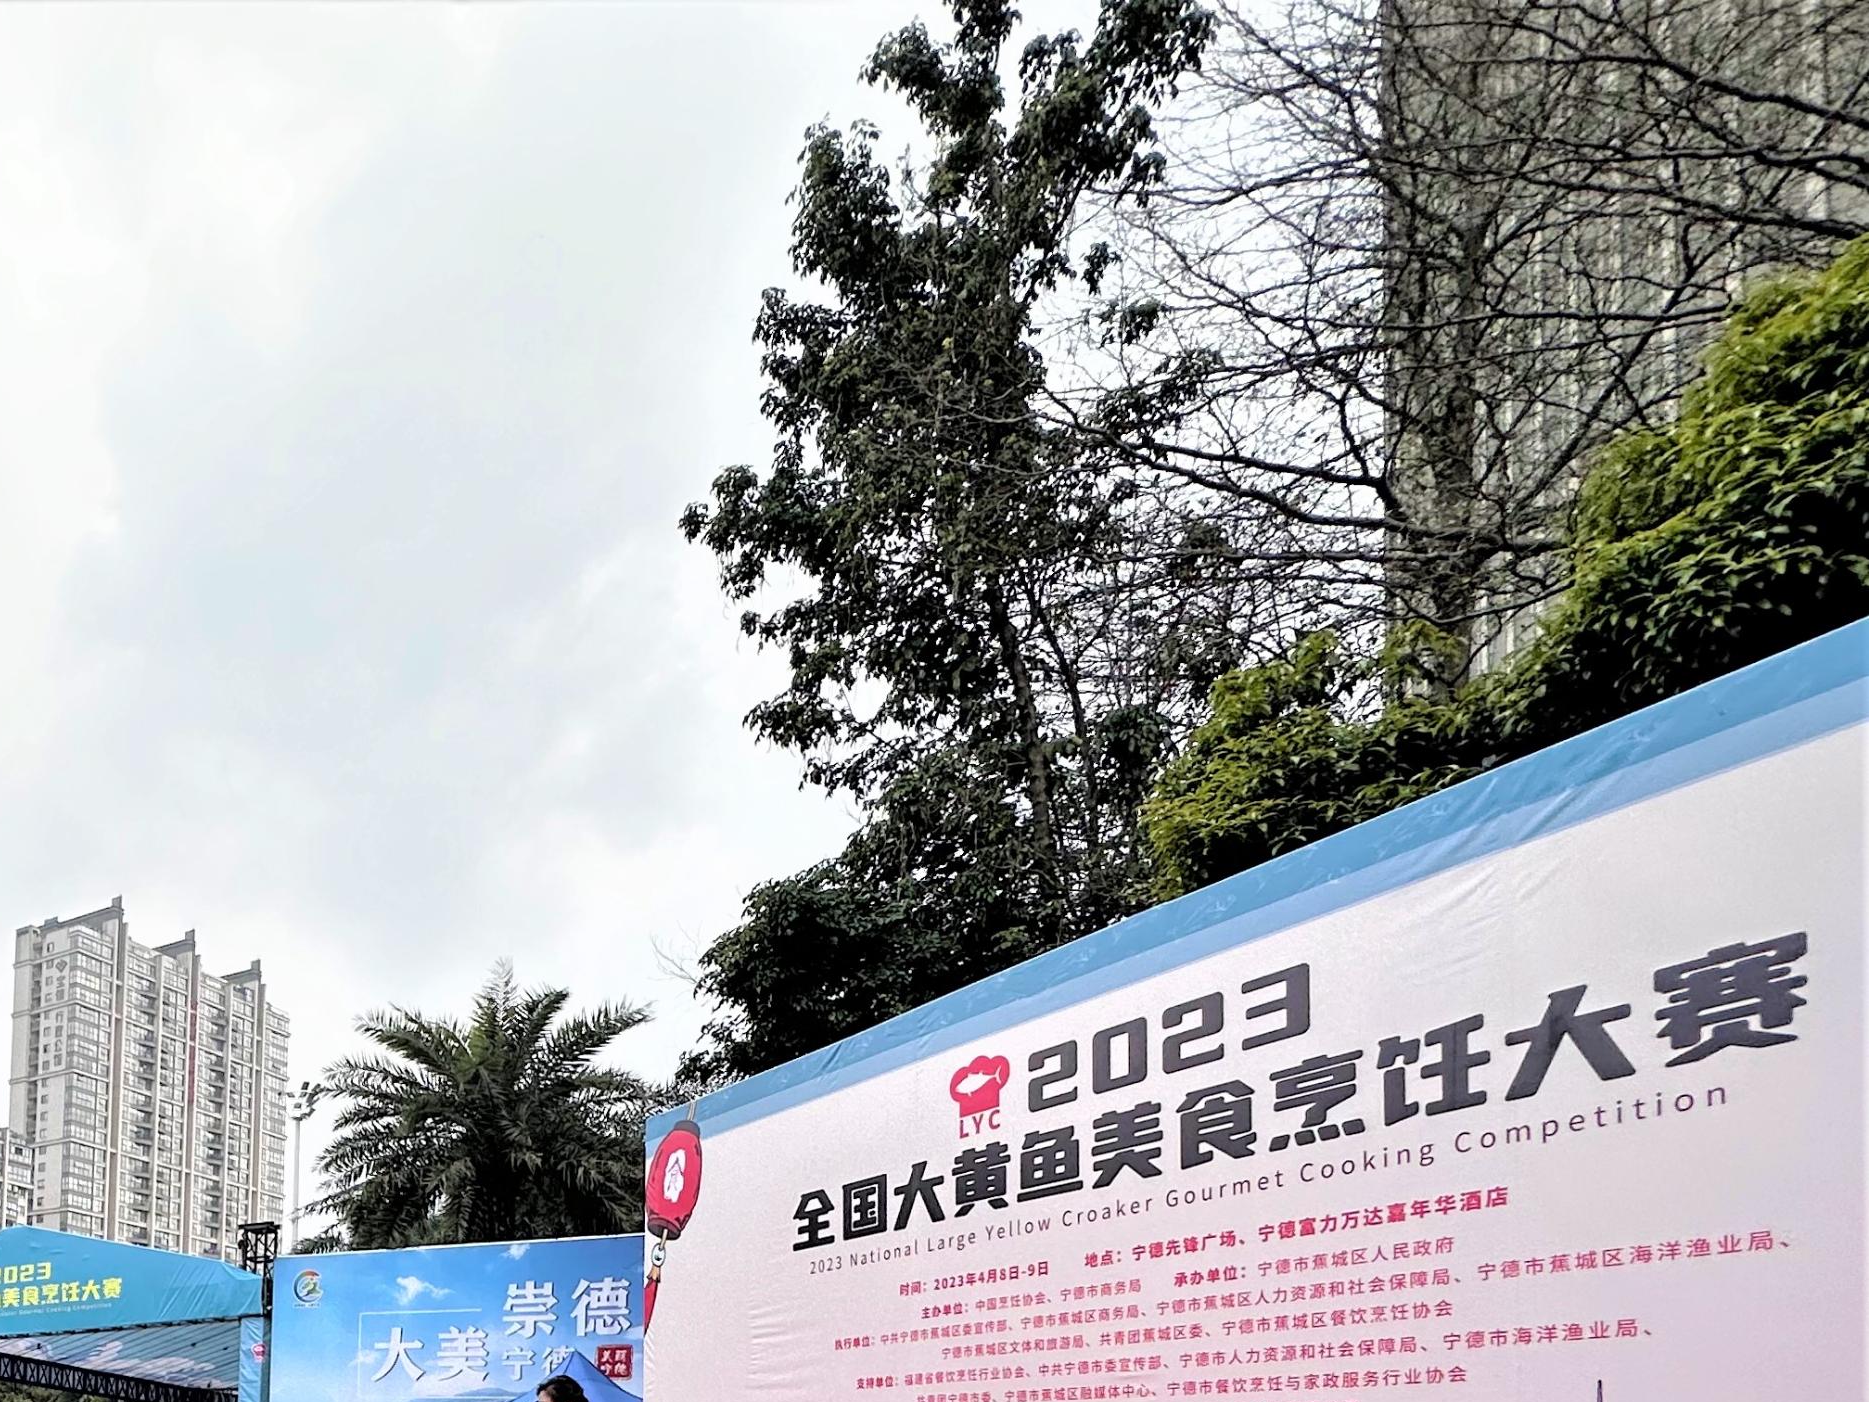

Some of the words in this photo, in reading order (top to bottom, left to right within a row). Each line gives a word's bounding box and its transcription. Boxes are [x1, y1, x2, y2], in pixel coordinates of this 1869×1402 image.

[792, 931, 1809, 1252] 全国大黄鱼美食烹饪大赛
[1027, 962, 1310, 1113] 2023
[808, 1254, 842, 1275] 2023
[849, 1239, 918, 1268] National
[926, 1229, 977, 1254] Large
[985, 1215, 1051, 1241] Yellow
[1061, 1194, 1153, 1227] Croaker
[1166, 1169, 1284, 1208] Gourmet
[1299, 1142, 1435, 1183] Cooking
[1454, 1085, 1727, 1153] Competition
[958, 1111, 1001, 1139] LYC
[502, 1276, 631, 1340] 崇德
